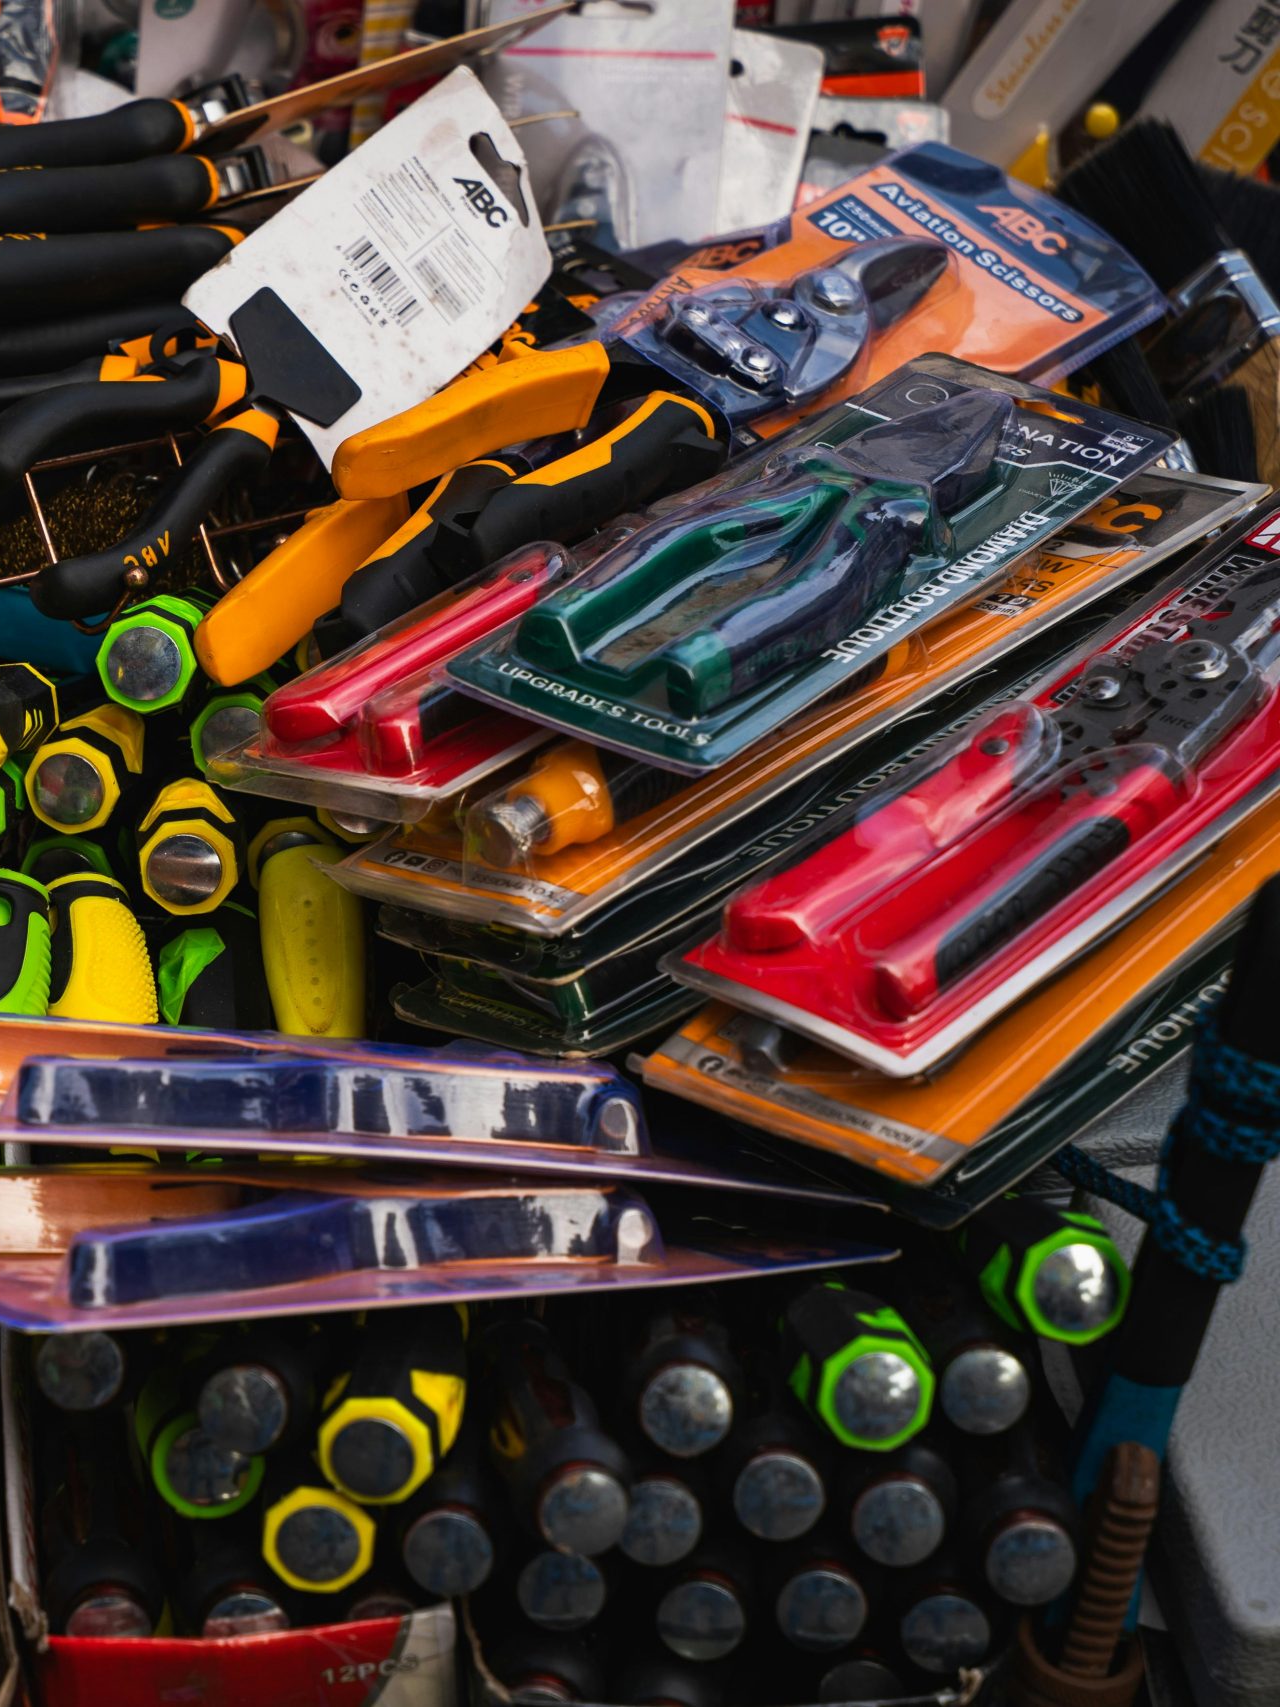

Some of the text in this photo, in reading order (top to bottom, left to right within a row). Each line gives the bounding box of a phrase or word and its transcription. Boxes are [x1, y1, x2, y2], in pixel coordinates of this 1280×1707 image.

[451, 176, 508, 228] ABC
[976, 204, 1068, 256] ABC
[877, 183, 1080, 322] Aviation Scissors
[1004, 423, 1126, 468] NATION
[939, 510, 1052, 585] DIAMOND
[821, 582, 952, 664] BOUTIQUE
[497, 662, 713, 746] UPGRADES TOOLS
[740, 761, 907, 858] BOUTIQUE
